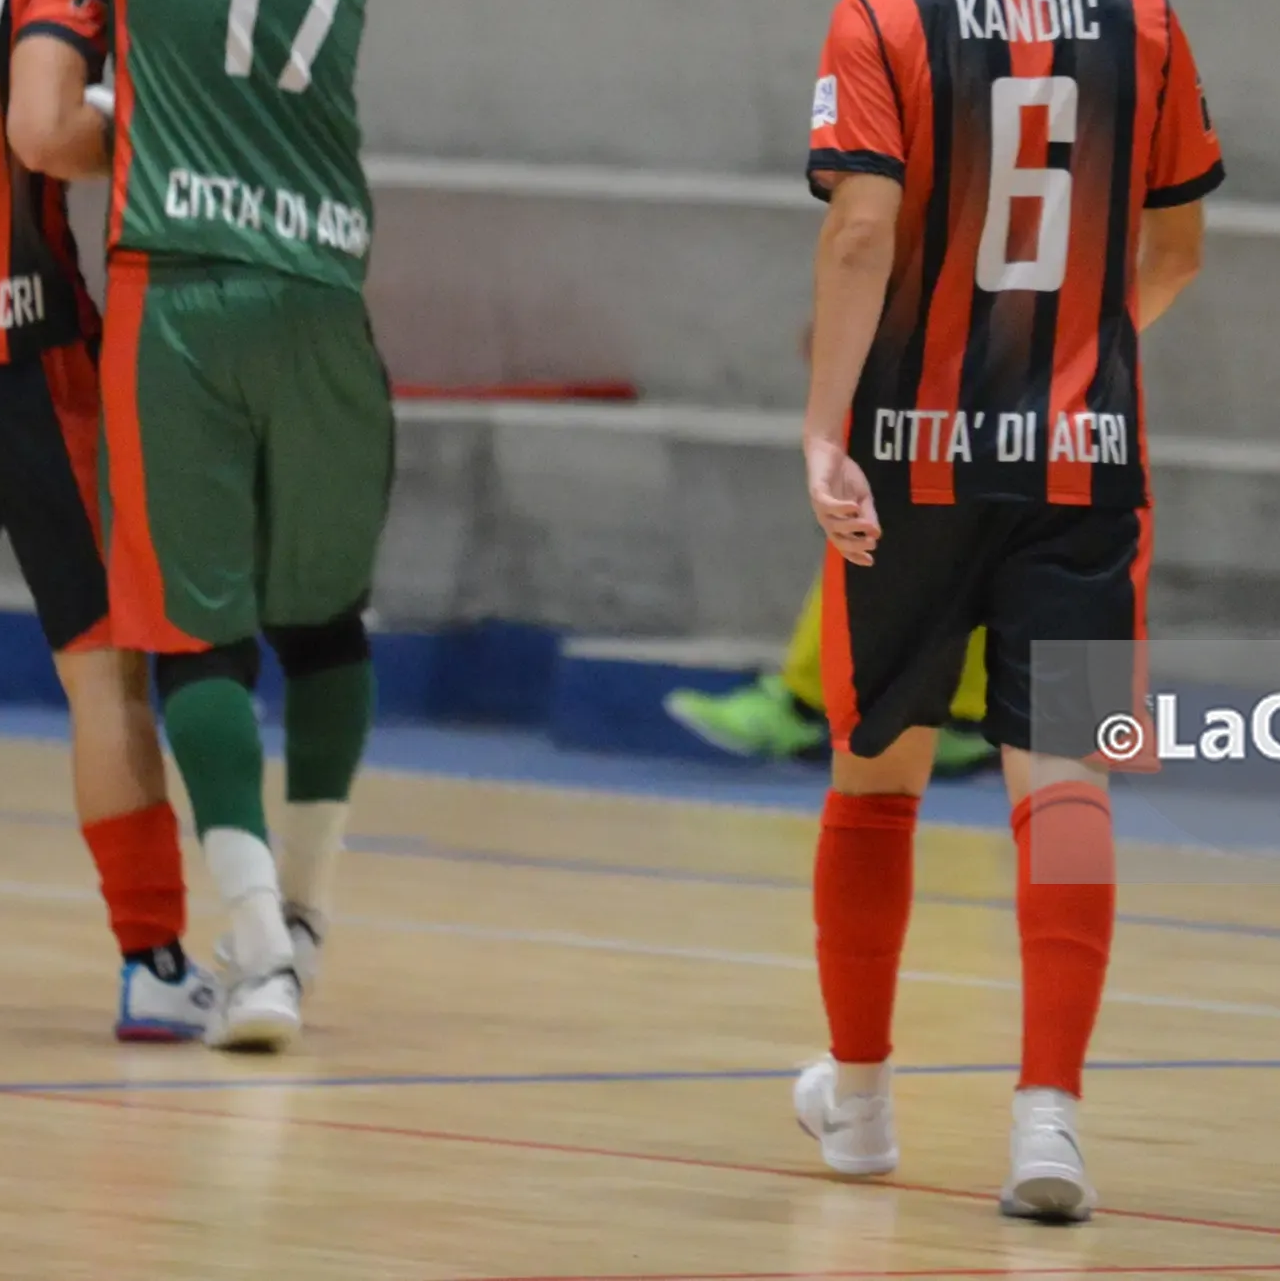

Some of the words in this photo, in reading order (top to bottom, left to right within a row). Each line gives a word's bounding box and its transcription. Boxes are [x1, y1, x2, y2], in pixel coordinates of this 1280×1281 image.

[975, 76, 1079, 293] 6
[275, 188, 308, 241] DI
[873, 408, 983, 463] CITTA'
[997, 412, 1036, 463] DI
[1048, 411, 1129, 465] ACRI
